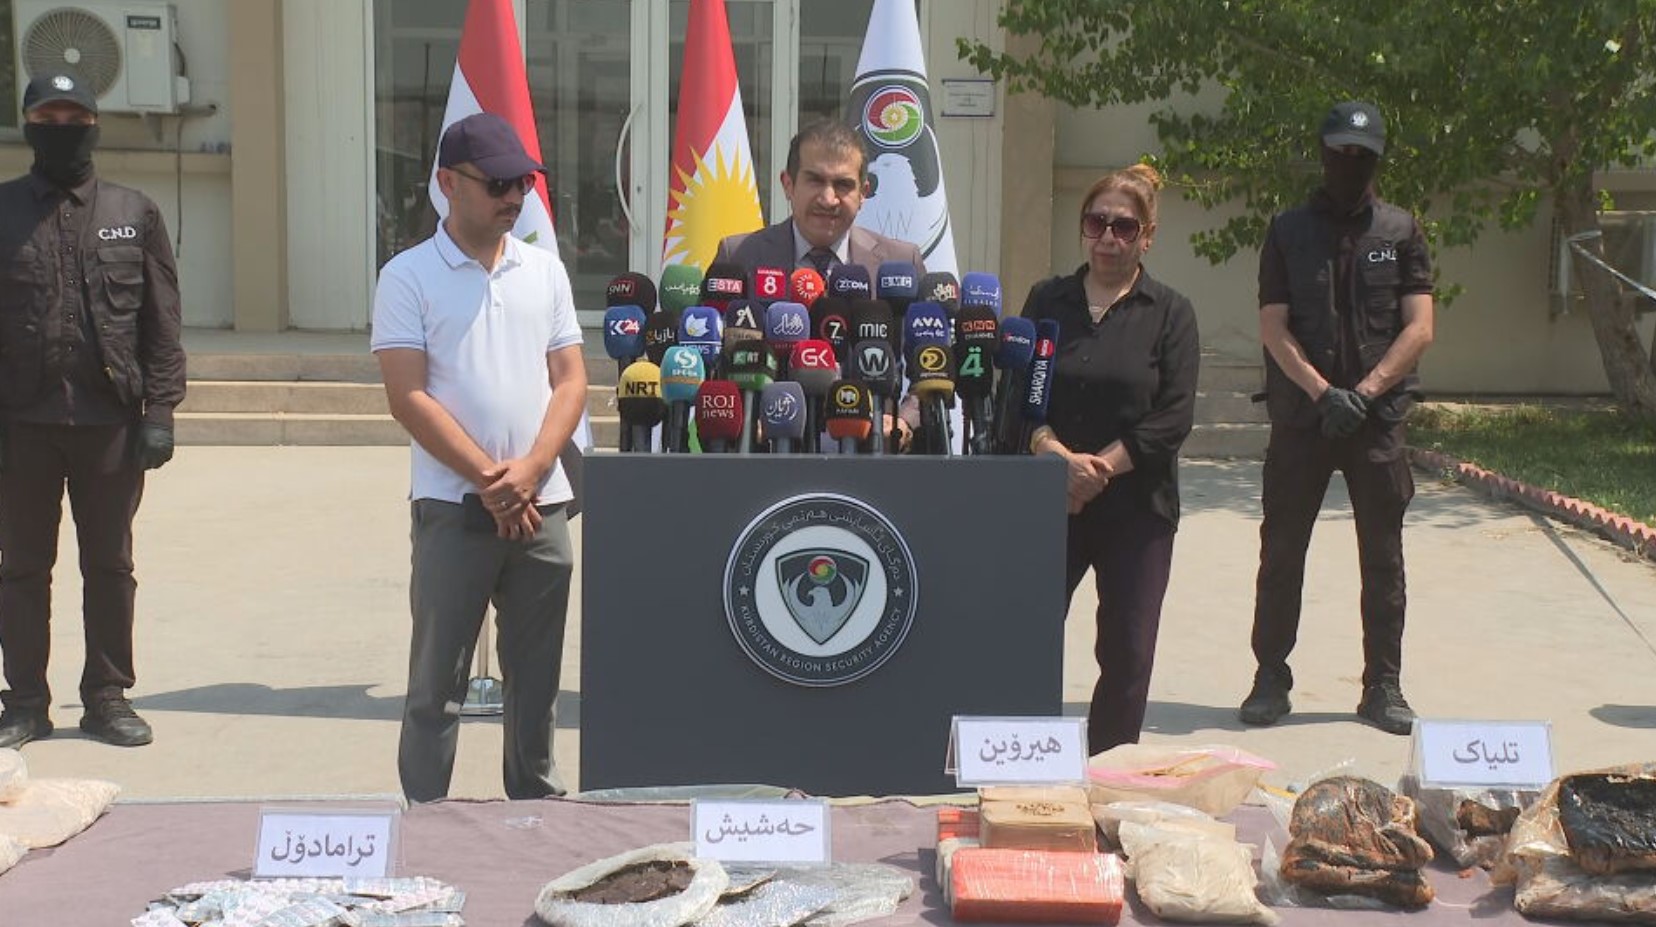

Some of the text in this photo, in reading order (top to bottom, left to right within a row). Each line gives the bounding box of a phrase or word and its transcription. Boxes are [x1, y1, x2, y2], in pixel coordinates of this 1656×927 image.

[98, 226, 137, 240] C.N.D
[708, 279, 742, 293] ESTA
[763, 276, 777, 294] 8
[912, 317, 944, 329] AVA
[801, 348, 830, 367] GK
[625, 381, 659, 396] NRT
[1029, 360, 1048, 405] SHARQIYA
[702, 395, 736, 409] ROJ
[703, 410, 735, 419] news
[741, 605, 902, 672] KURDISTAN REGION SECURITY AGENCY
[979, 733, 1062, 766] هیرۆین
[1452, 739, 1521, 770] تلیاک
[705, 813, 816, 844] حەشیش
[271, 830, 376, 866] ترامادۆڵ
